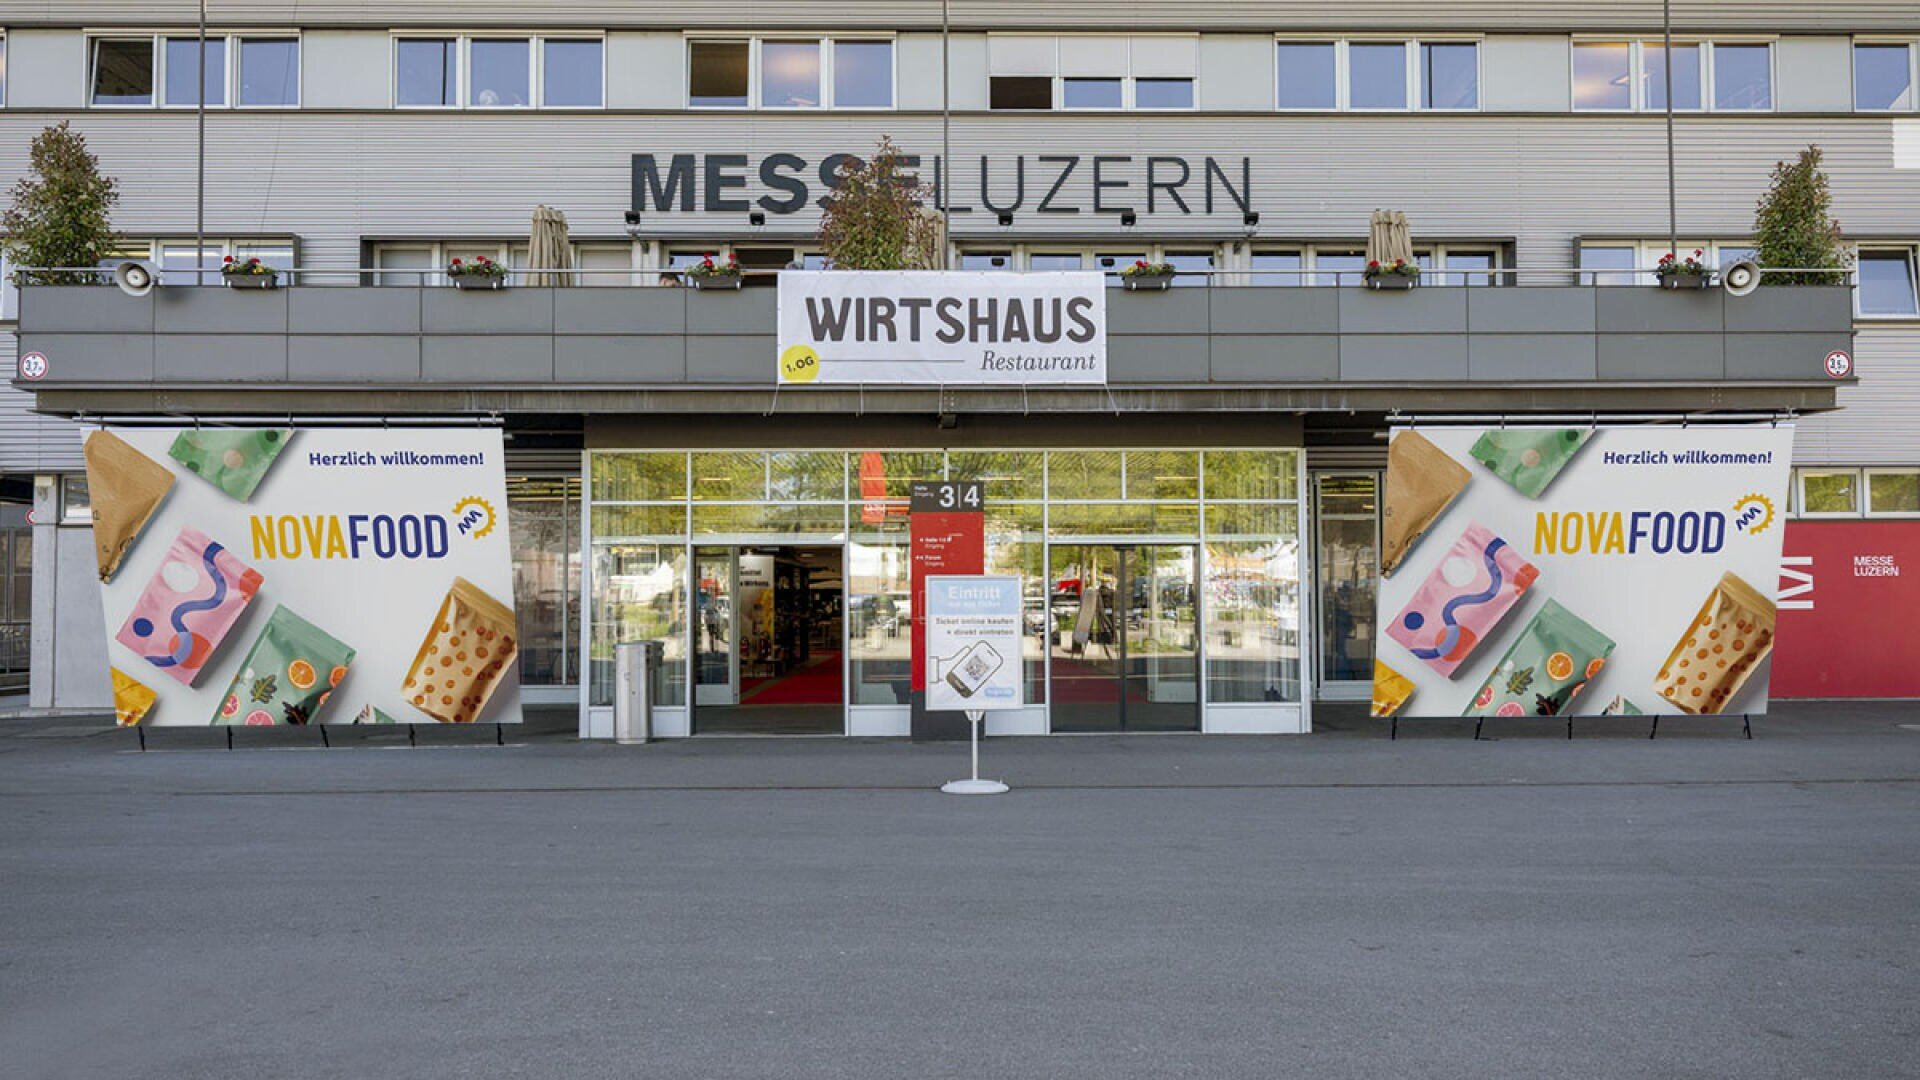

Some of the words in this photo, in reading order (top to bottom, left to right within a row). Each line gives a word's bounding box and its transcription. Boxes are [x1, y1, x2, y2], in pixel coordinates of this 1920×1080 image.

[805, 296, 1096, 343] WIRTSHAUS
[980, 350, 1096, 372] Restaurant
[309, 451, 376, 465] Herzlich
[381, 451, 484, 465] willkommen!
[1603, 451, 1667, 465] Herzlich
[1673, 451, 1772, 465] willkommen!
[249, 514, 449, 560] NOVAFOOD
[1533, 511, 1726, 555] NOVAFOOD
[1854, 555, 1894, 565] MESSE
[1854, 566, 1899, 576] LUZERN
[948, 585, 1001, 600] Eintritt
